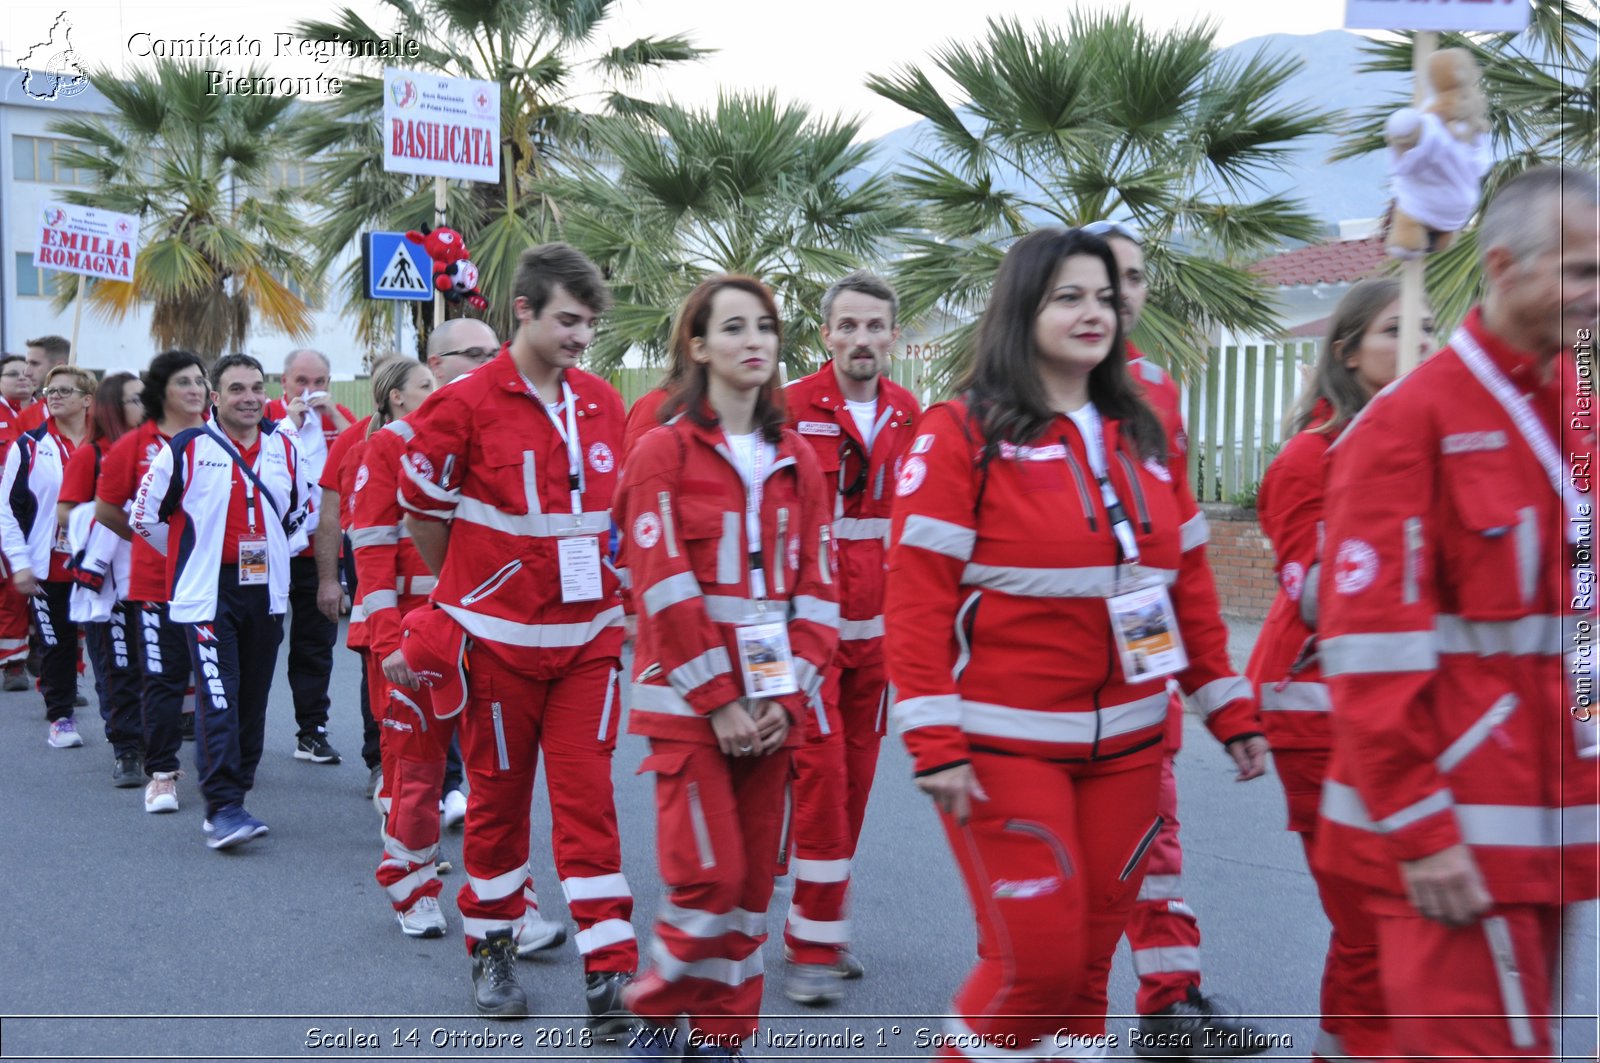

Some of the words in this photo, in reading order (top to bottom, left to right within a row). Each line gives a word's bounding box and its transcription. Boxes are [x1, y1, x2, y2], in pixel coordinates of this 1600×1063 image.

[391, 117, 494, 168] BASILICATA
[39, 246, 130, 277] ROMAGNA
[42, 227, 132, 260] EMILIA
[33, 596, 58, 647] Zeus
[110, 611, 129, 668] Zeus
[141, 610, 164, 674] Zeus
[198, 643, 229, 711] Zeus
